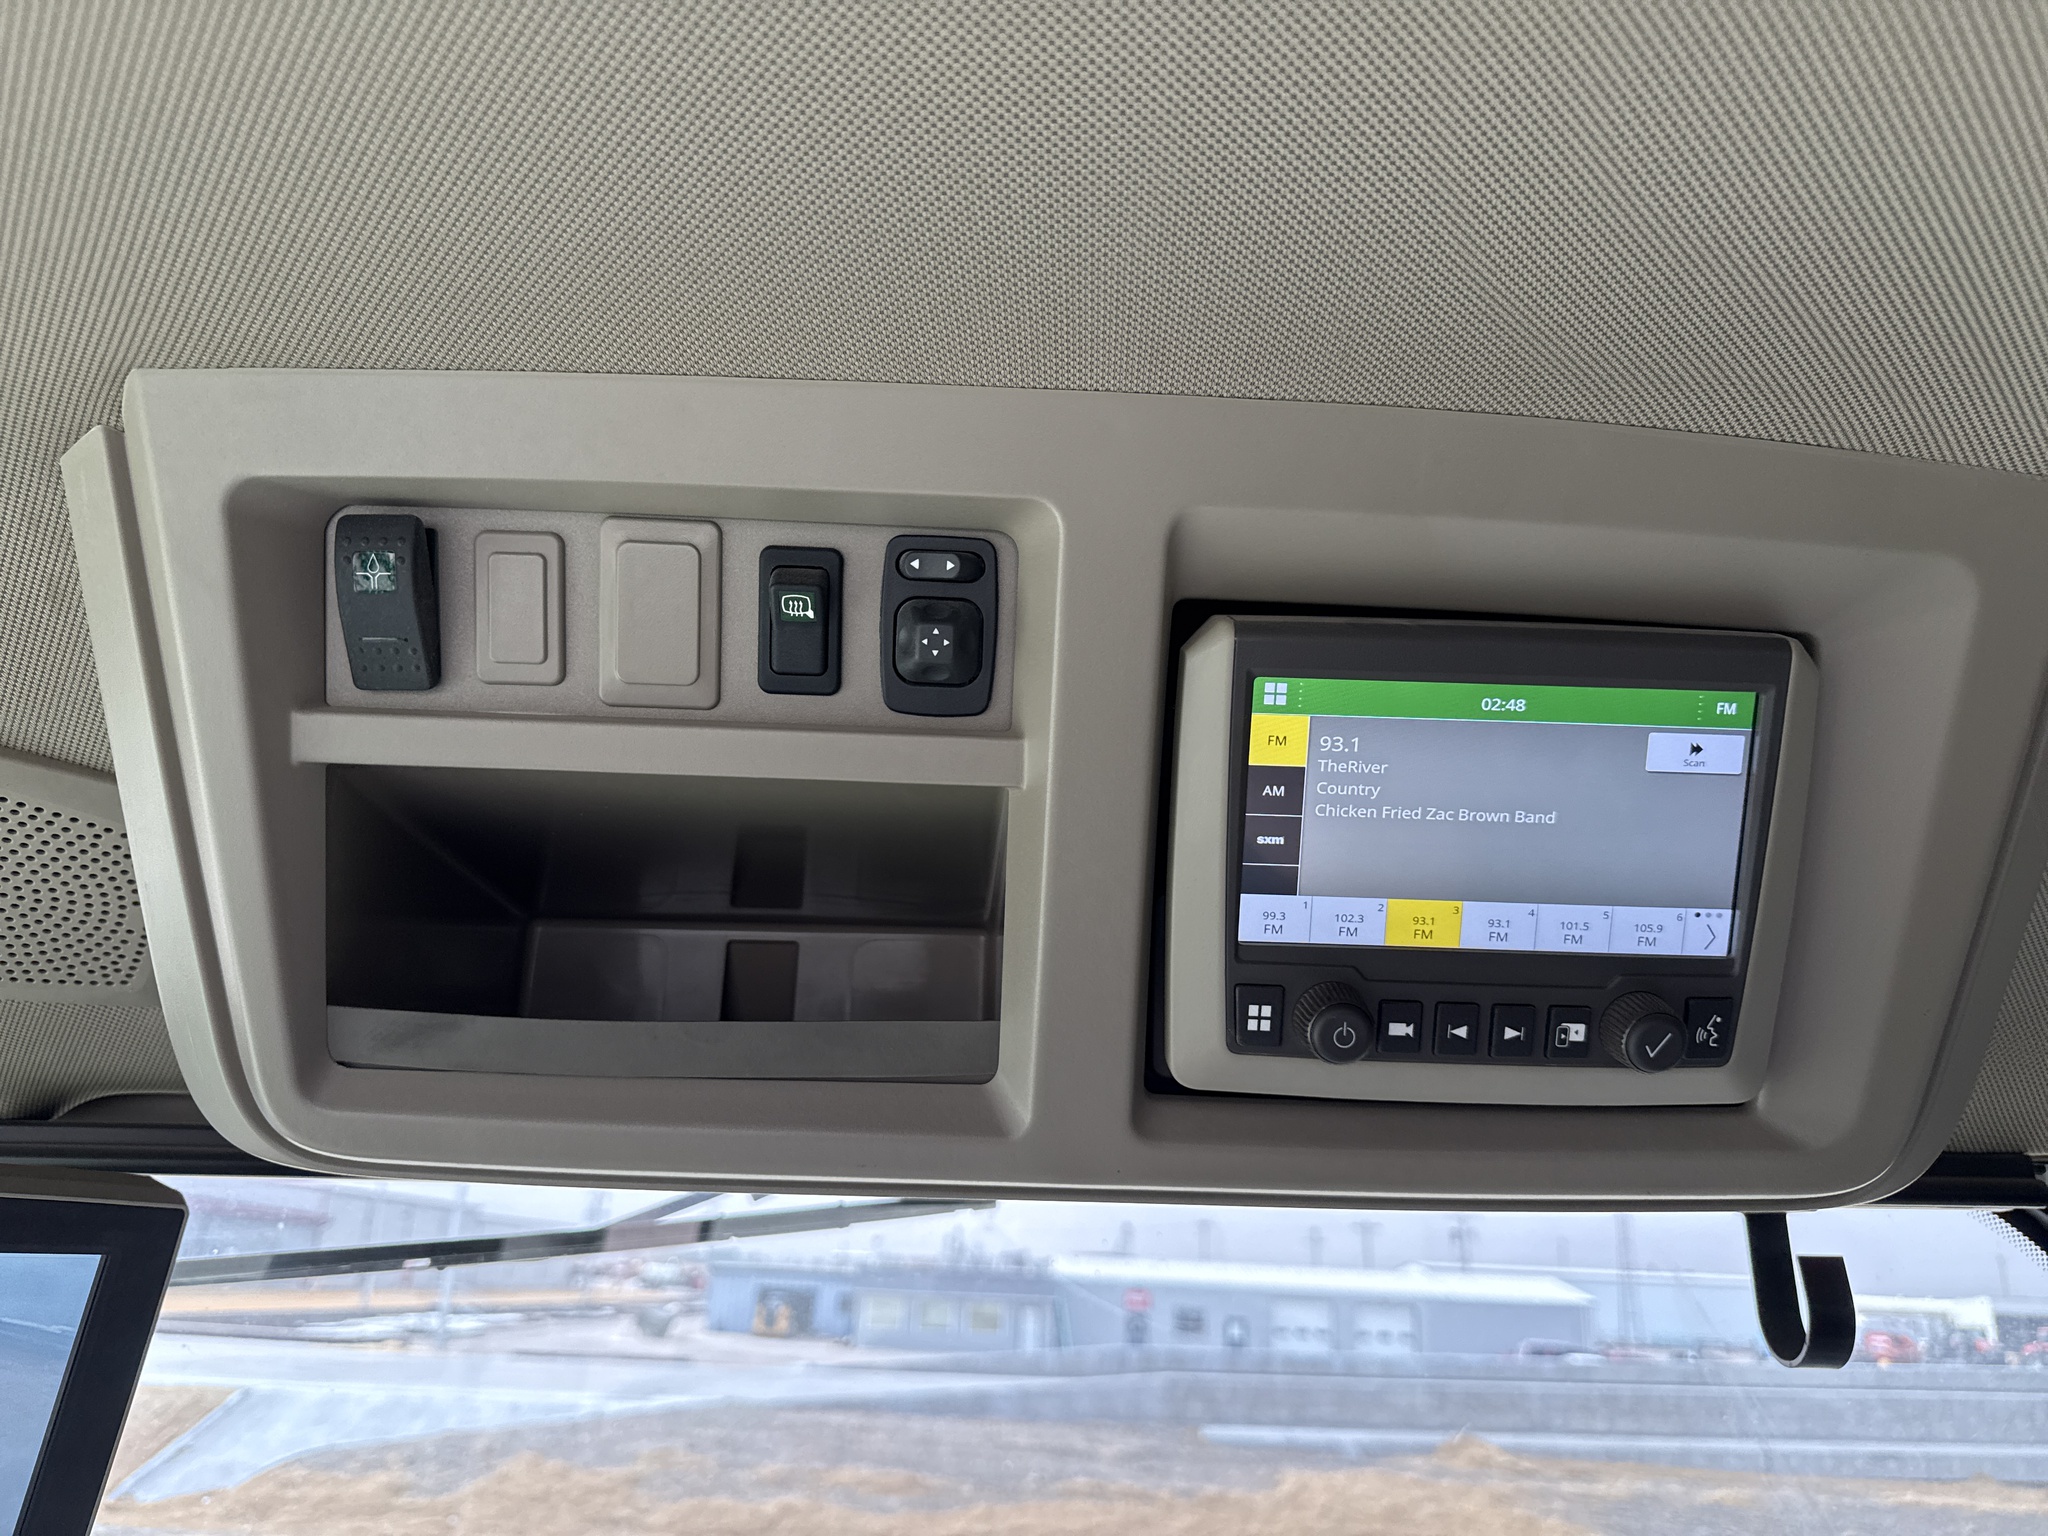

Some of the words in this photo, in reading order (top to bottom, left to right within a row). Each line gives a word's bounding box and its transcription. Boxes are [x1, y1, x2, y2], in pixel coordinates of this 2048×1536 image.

[1481, 698, 1526, 711] 02:48
[1716, 702, 1737, 715] FM
[1267, 735, 1287, 746] FM
[1319, 736, 1359, 752] 93.1
[1317, 759, 1388, 774] TheRiver
[1683, 759, 1705, 767] Scan
[1262, 786, 1285, 796] AM
[1316, 782, 1380, 799] Country
[1315, 804, 1377, 818] Chicken
[1382, 806, 1421, 820] Fried
[1426, 808, 1454, 821] Zac
[1458, 809, 1509, 823] Brown
[1514, 810, 1556, 824] Band
[1303, 901, 1308, 909] 1
[1377, 904, 1384, 912] 2
[1452, 906, 1460, 915] 3
[1262, 911, 1286, 921] 99.3
[1334, 913, 1364, 924] 102.3
[1528, 909, 1535, 917] 4
[1602, 911, 1610, 920] 5
[1676, 913, 1683, 922] 6
[1412, 916, 1435, 926] 93.1
[1487, 919, 1510, 929] 93.1
[1560, 921, 1590, 931] 101.5
[1263, 924, 1283, 935] FM
[1338, 926, 1358, 937] FM
[1634, 923, 1663, 934] 105.9
[1413, 929, 1433, 940] FM
[1488, 931, 1508, 942] FM
[1563, 934, 1583, 945] FM
[1637, 936, 1657, 947] FM
